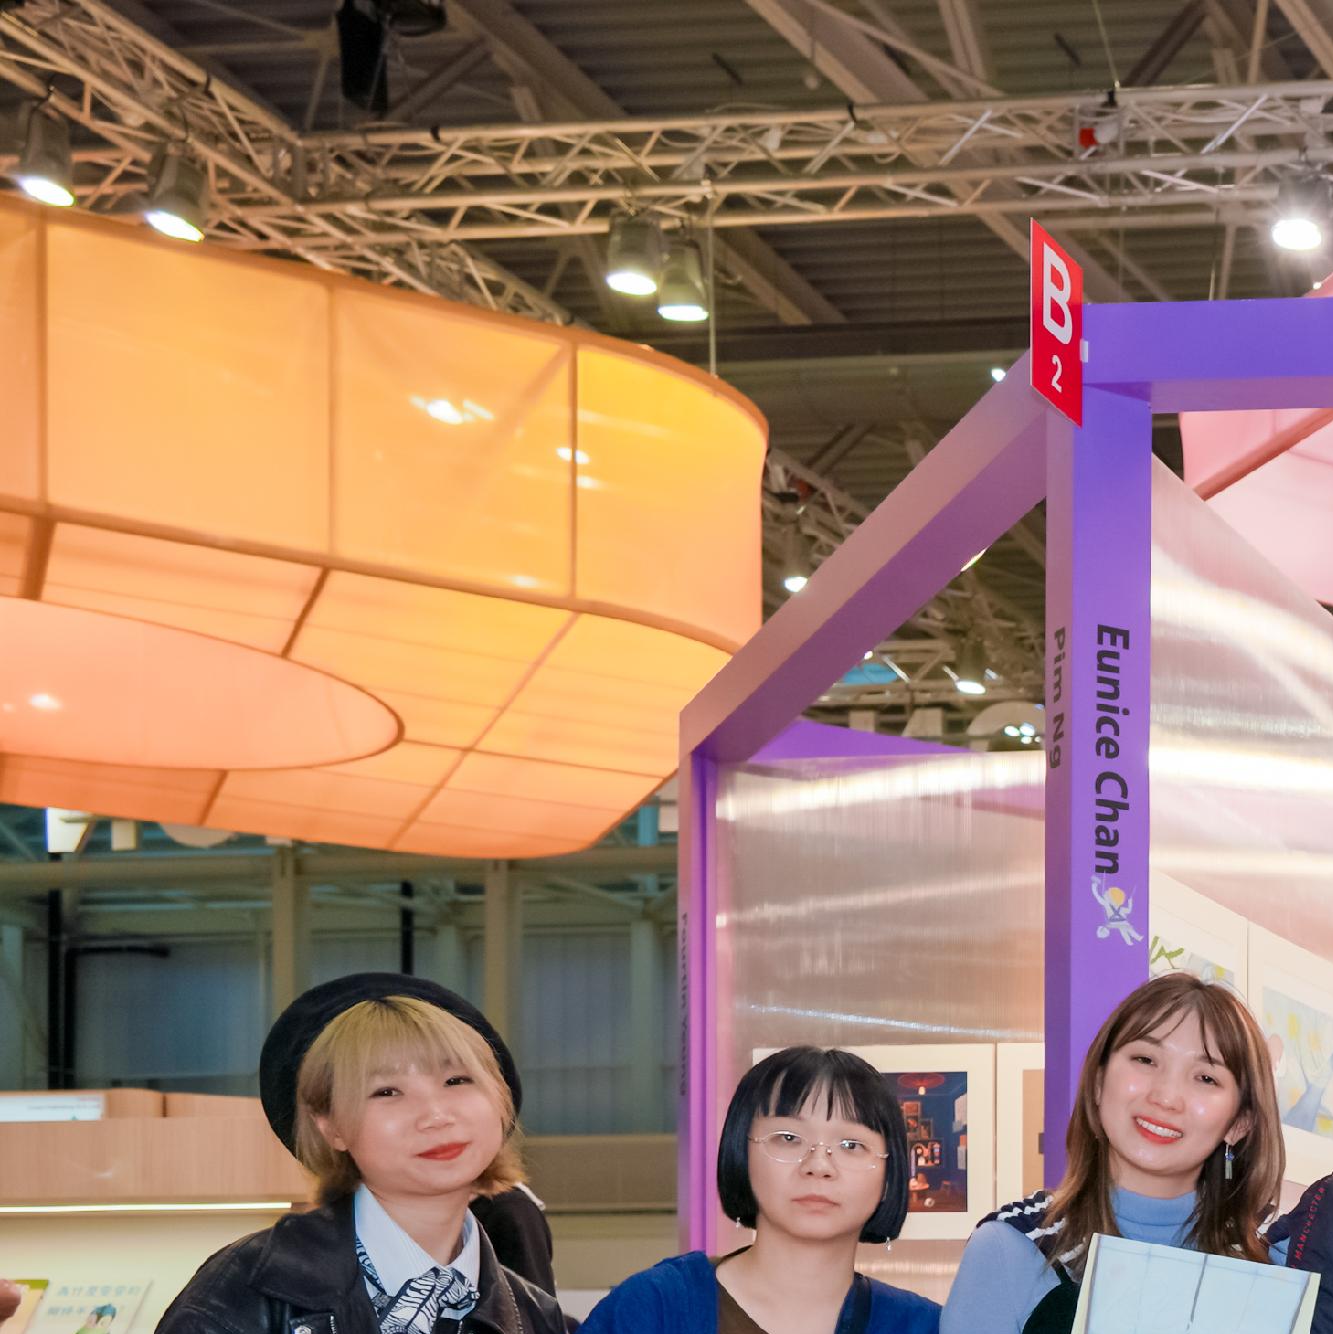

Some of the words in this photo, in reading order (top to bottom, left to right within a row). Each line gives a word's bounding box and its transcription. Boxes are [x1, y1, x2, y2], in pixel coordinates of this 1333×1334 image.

[1043, 242, 1073, 345] B
[1051, 354, 1063, 393] 2
[1053, 626, 1066, 704] Pim
[1096, 624, 1130, 759] Eunice
[1050, 712, 1065, 769] Ng
[1095, 771, 1130, 874] Chan
